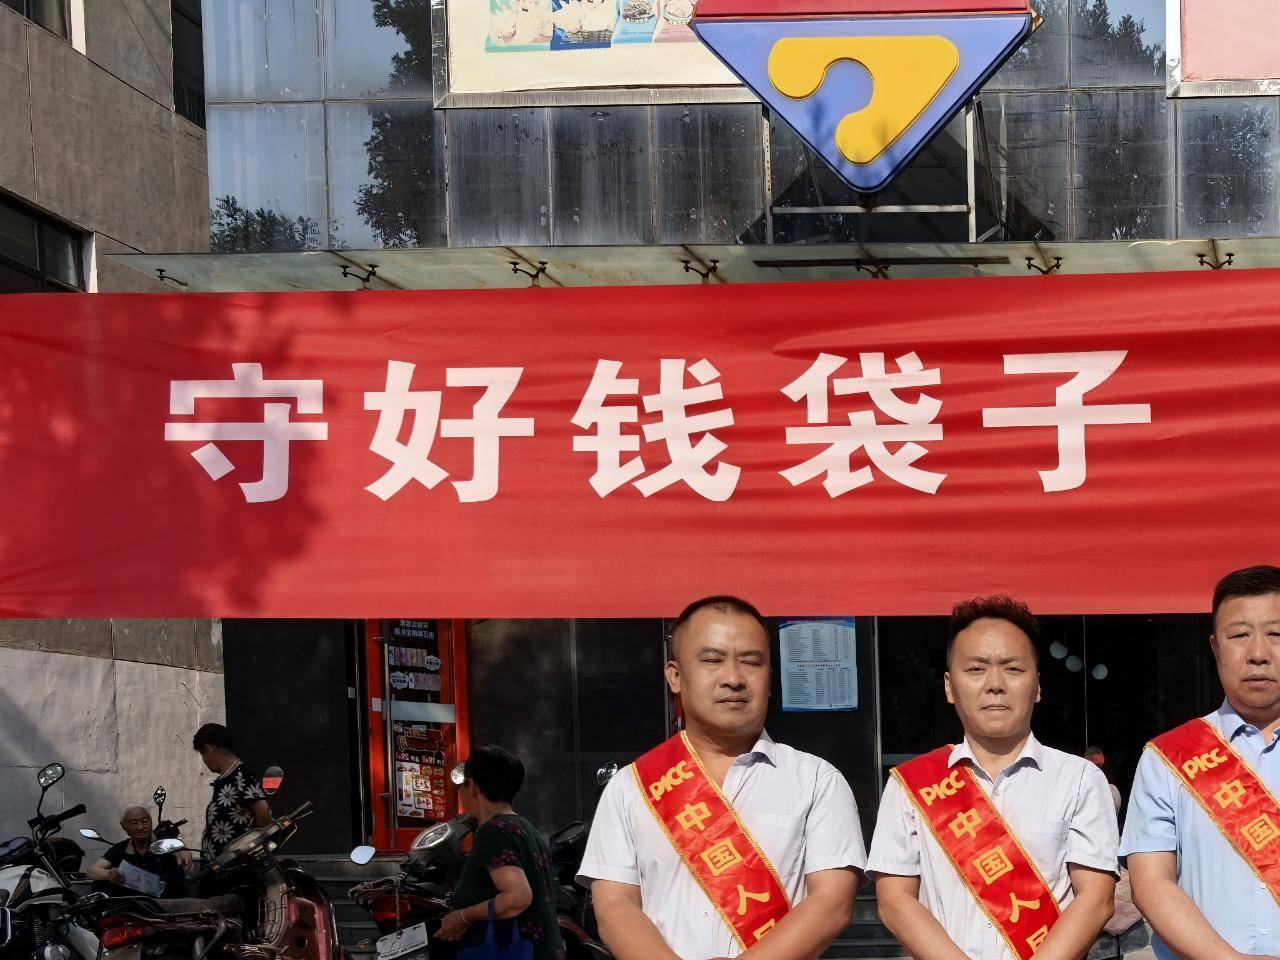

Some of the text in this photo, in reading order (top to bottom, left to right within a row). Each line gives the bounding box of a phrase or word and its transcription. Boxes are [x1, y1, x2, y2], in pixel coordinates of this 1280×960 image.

[164, 349, 1152, 503] 守好钱袋子
[650, 761, 694, 801] PICC
[1182, 747, 1227, 780] PICC
[919, 770, 964, 807] PICC
